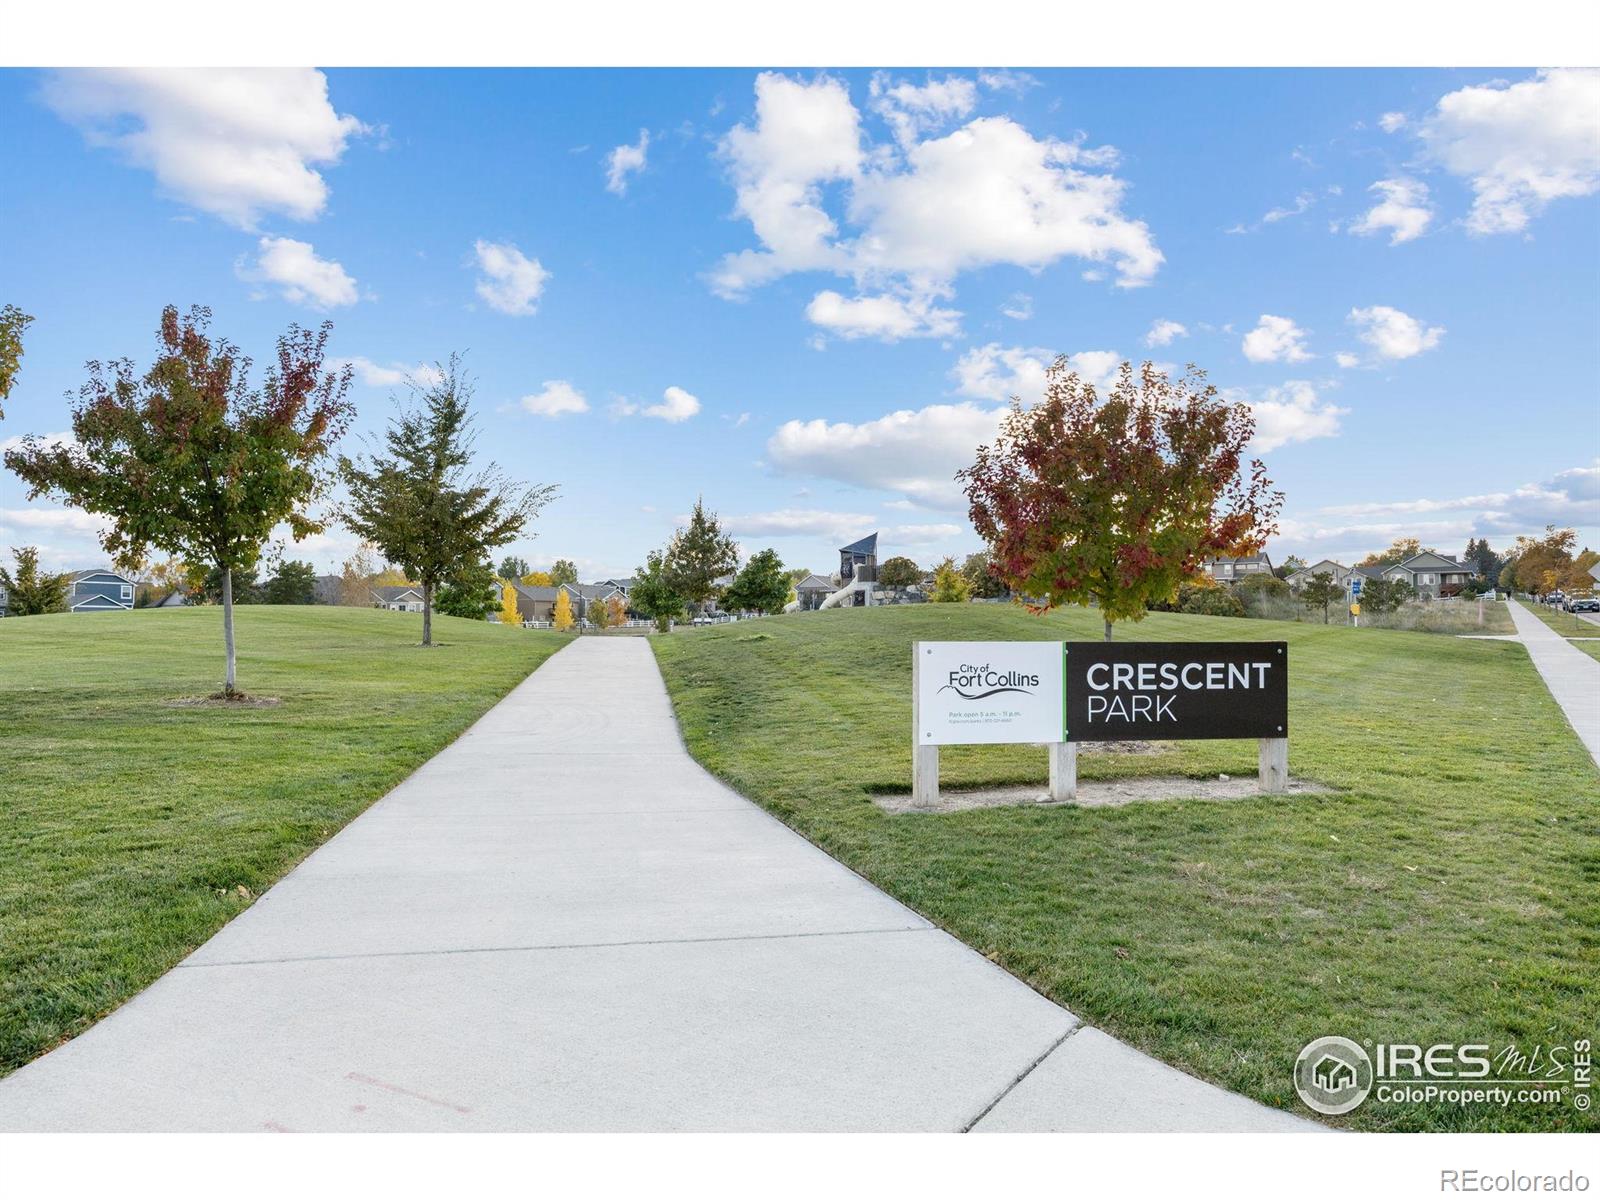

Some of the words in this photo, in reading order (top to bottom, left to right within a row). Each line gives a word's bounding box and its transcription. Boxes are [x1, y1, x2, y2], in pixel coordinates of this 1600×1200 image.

[949, 671, 982, 687] Fort
[985, 671, 1039, 687] Collins
[960, 663, 979, 675] City
[980, 663, 990, 673] of
[1086, 662, 1272, 691] CRESCENT
[1087, 694, 1178, 723] PARK
